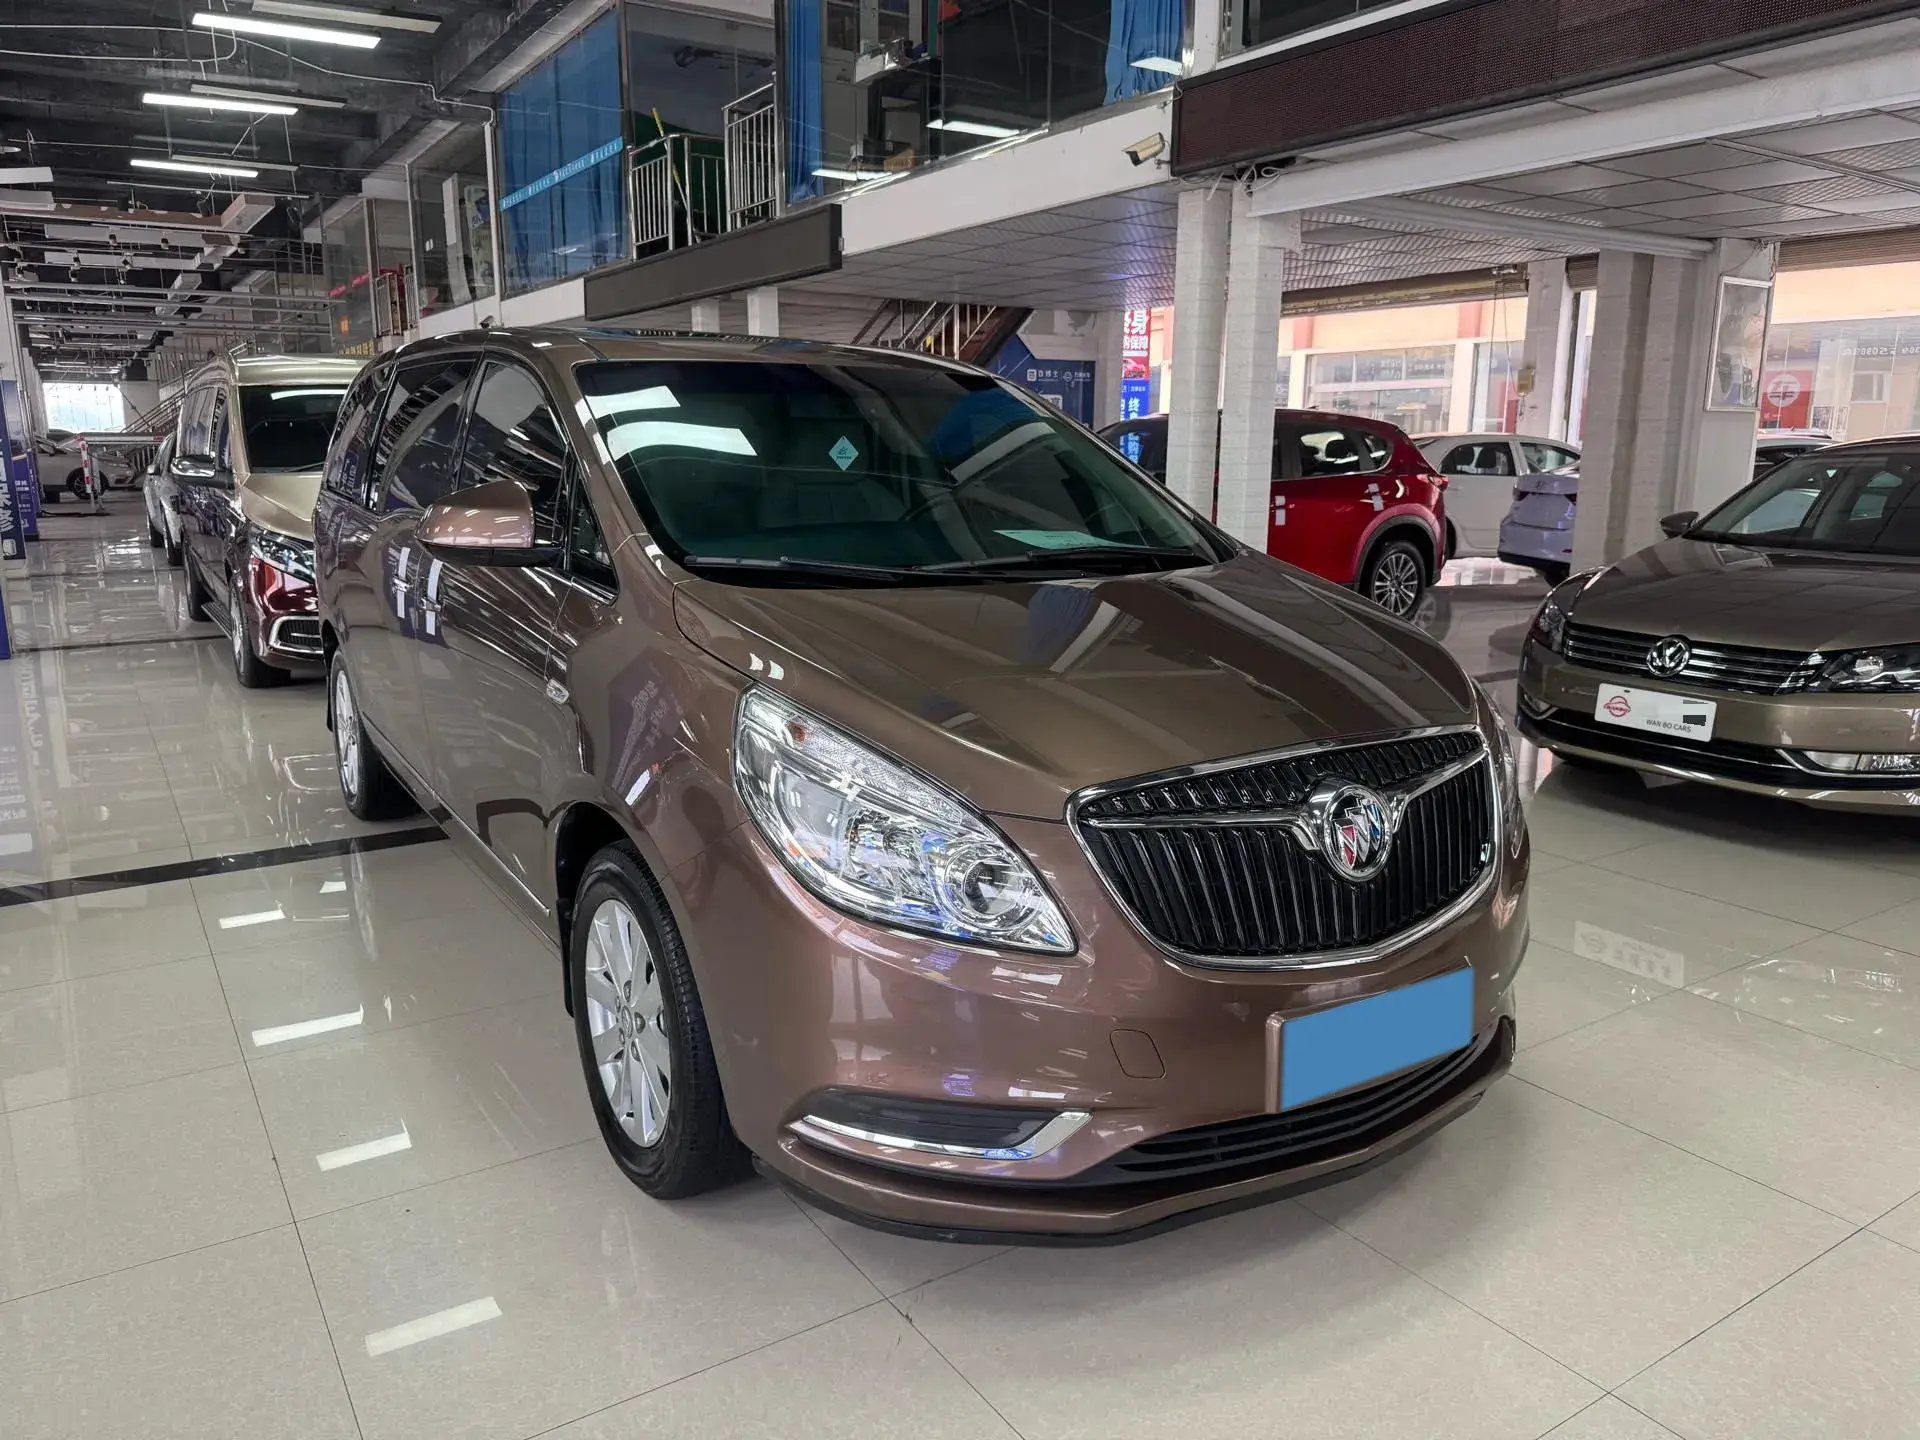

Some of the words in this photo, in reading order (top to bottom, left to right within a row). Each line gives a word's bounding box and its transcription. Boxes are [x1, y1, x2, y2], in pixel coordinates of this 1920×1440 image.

[1646, 719, 1661, 728] WAN
[1663, 722, 1672, 730] BO
[1673, 724, 1692, 733] CARS
